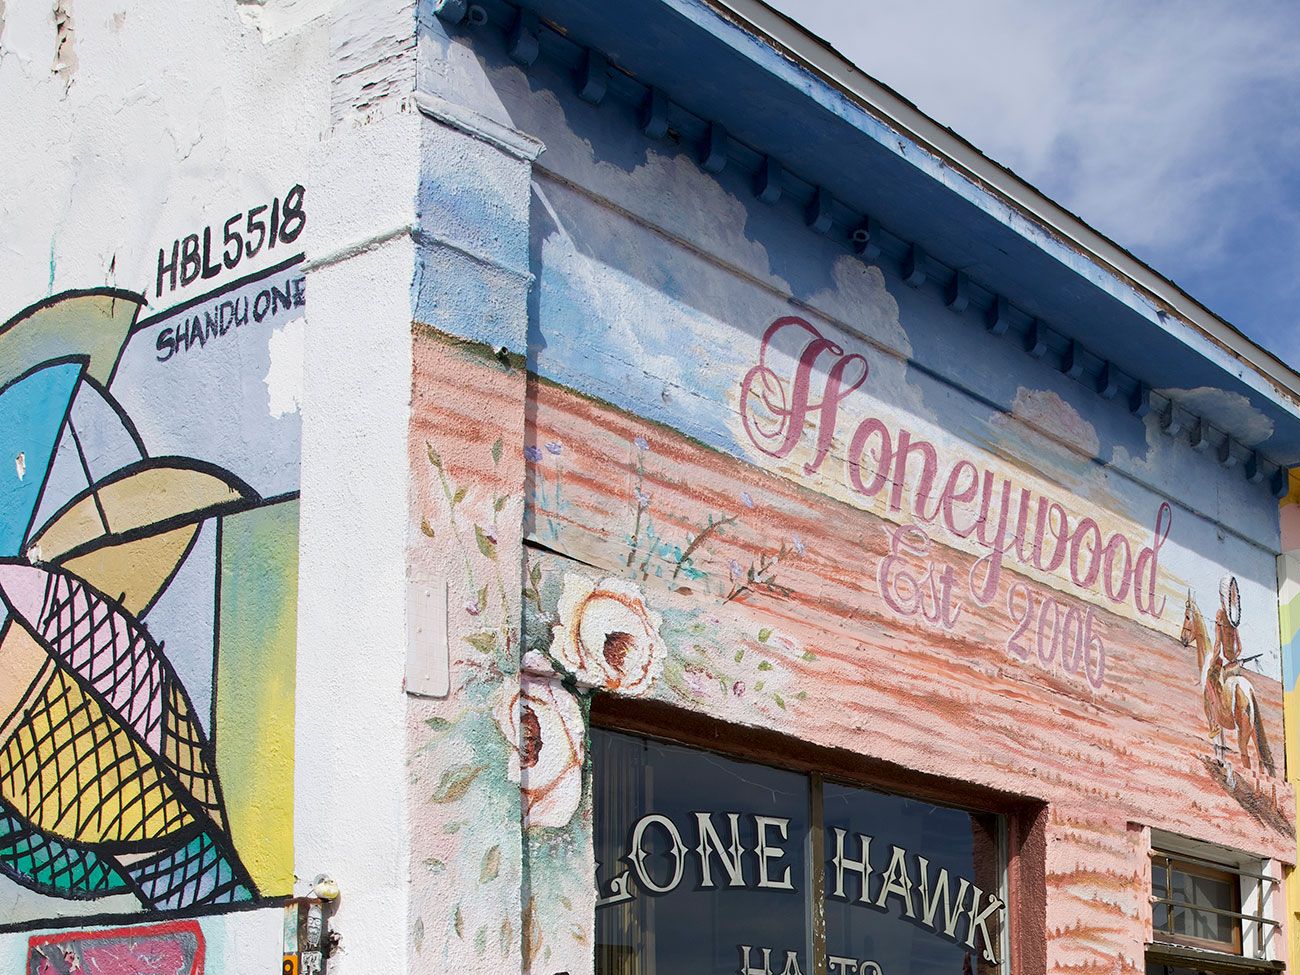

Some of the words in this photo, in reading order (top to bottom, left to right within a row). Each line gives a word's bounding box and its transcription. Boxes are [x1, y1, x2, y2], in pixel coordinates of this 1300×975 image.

[155, 183, 306, 298] HBL5518
[740, 316, 1171, 618] Honeywood
[878, 523, 961, 629] Est
[833, 827, 1005, 965] HAWK
